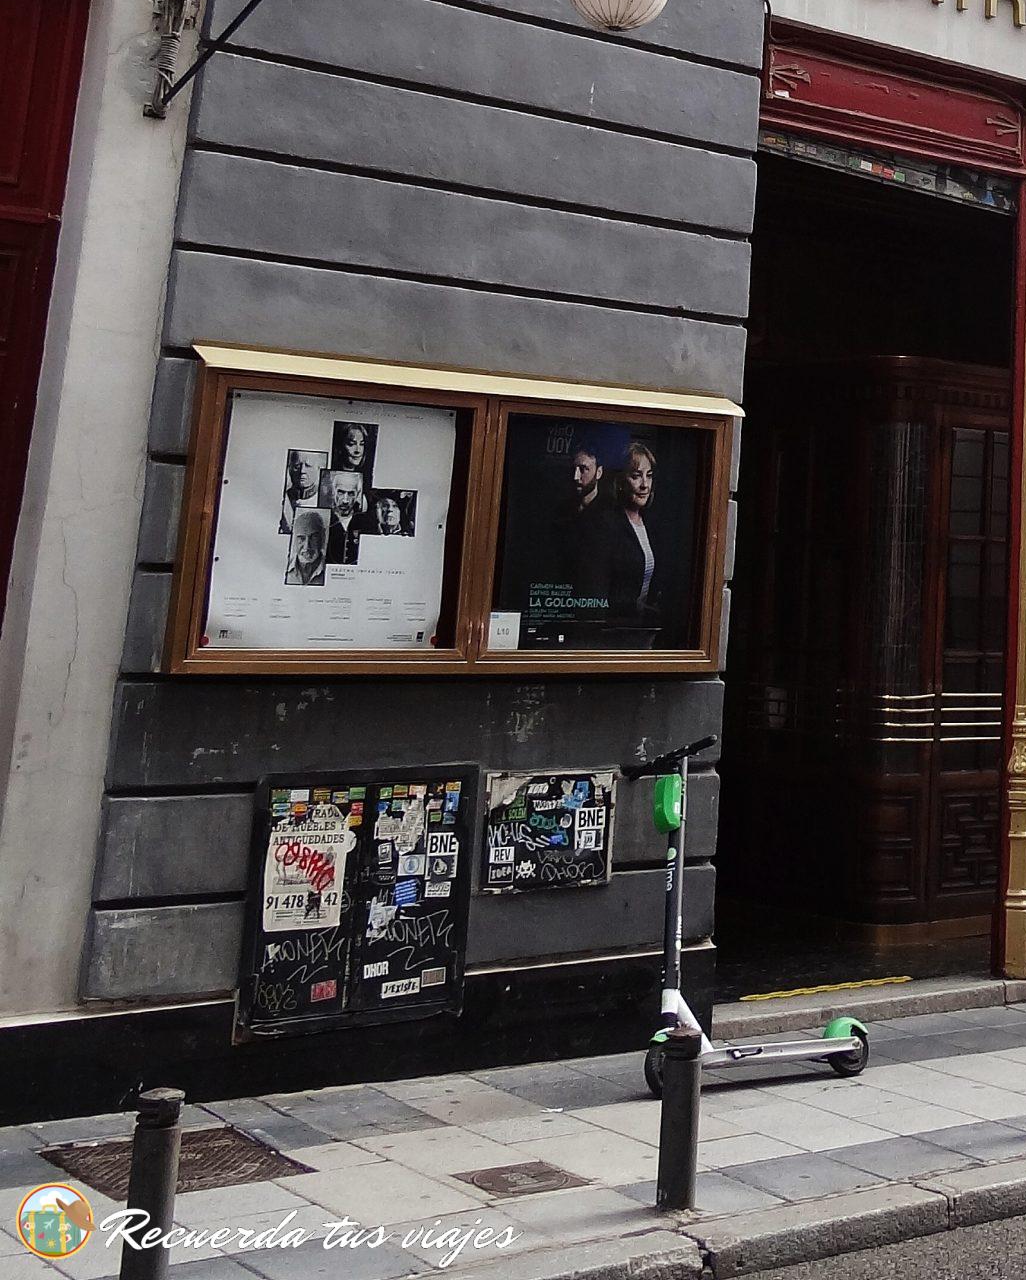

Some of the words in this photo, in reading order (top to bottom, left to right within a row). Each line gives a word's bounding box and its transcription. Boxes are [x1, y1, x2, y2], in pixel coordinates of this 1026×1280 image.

[529, 597, 542, 607] LA
[544, 597, 610, 608] GOLONDRINA
[580, 809, 604, 828] BNE
[429, 834, 457, 854] BNE
[493, 848, 511, 862] REV
[266, 895, 280, 910] 91
